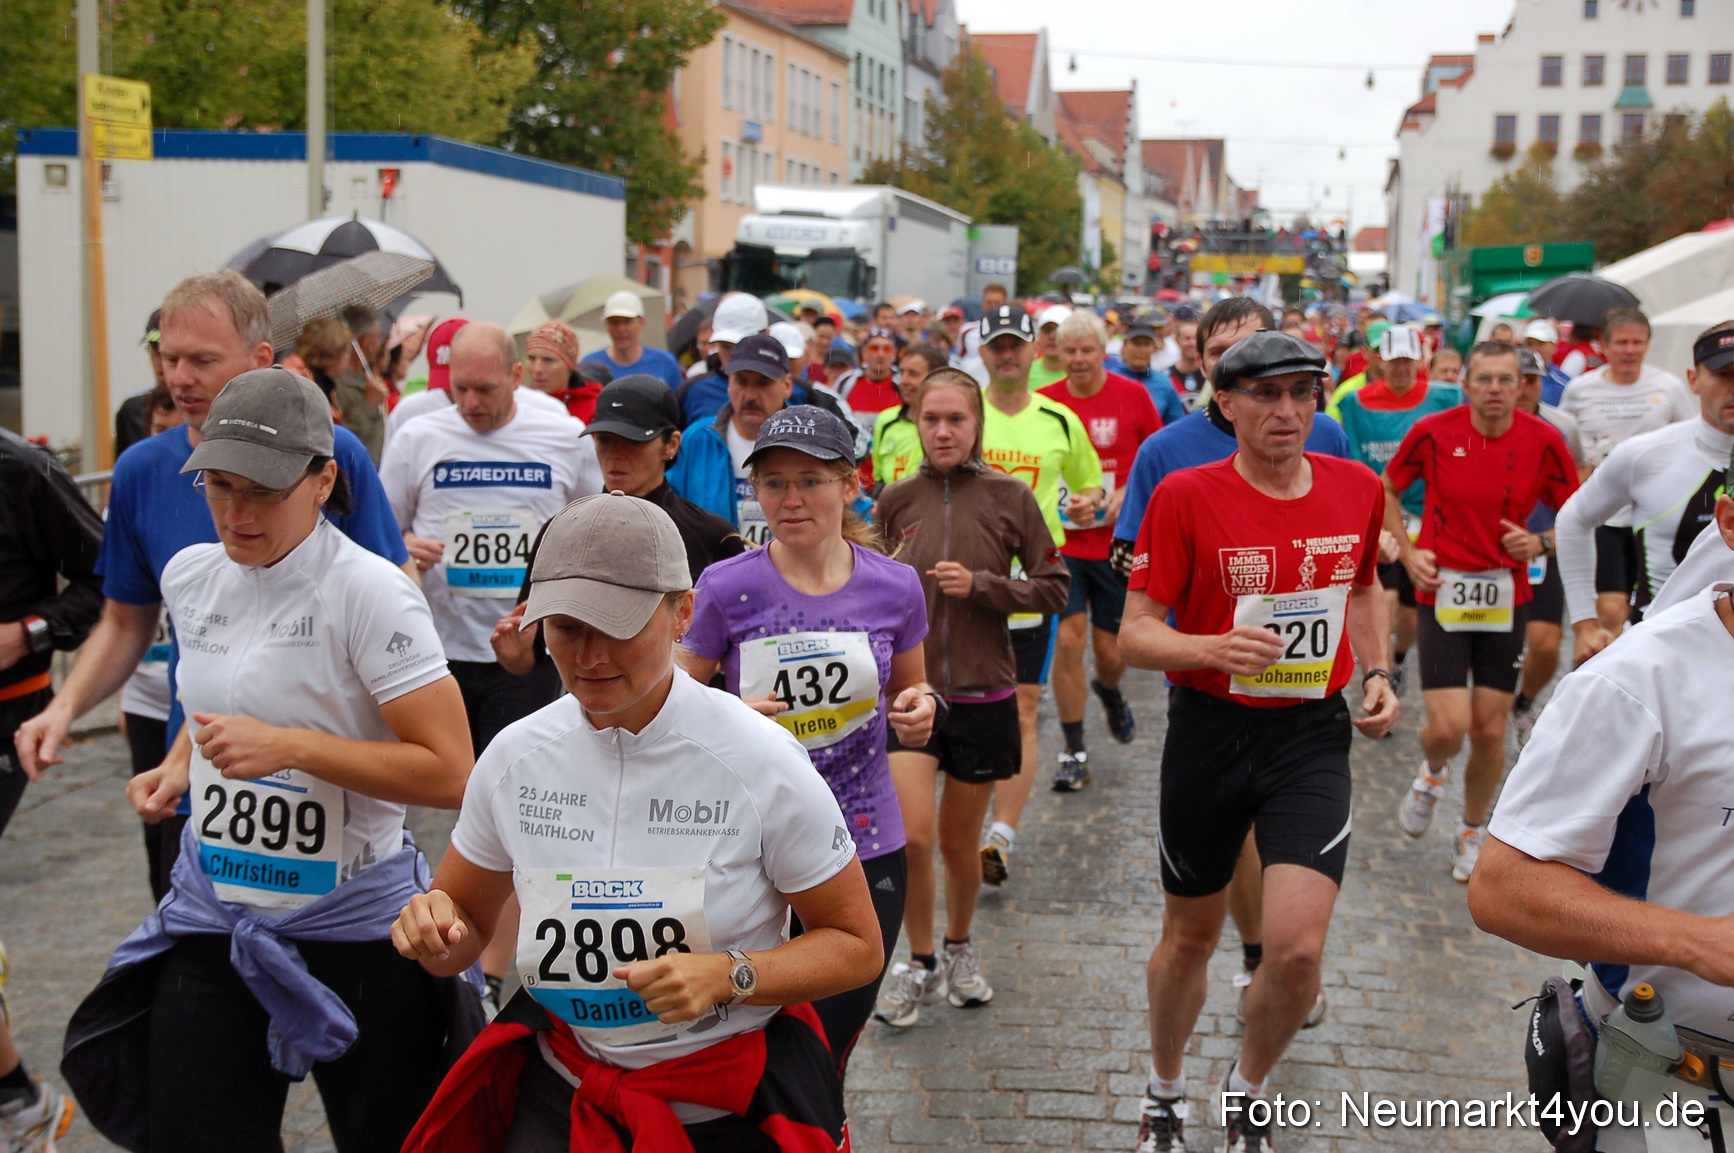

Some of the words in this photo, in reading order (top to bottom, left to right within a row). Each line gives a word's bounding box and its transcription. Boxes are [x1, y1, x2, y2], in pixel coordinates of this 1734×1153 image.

[450, 468, 546, 483] STAEDTLER
[454, 533, 531, 565] 2684
[1292, 539, 1306, 549] 11.
[1306, 534, 1361, 547] NEUMARKTER
[1305, 544, 1353, 556] STADTLAUF
[1229, 555, 1268, 566] IMMER
[1227, 565, 1271, 575] WIEDER
[469, 572, 515, 586] Markus
[1231, 574, 1268, 587] NEU
[1231, 587, 1267, 596] MARKT
[1453, 582, 1498, 606] 340
[1273, 597, 1319, 612] BOCK
[778, 639, 830, 656] BOCK
[1255, 669, 1328, 684] Johannes
[769, 661, 851, 711] 432
[794, 717, 838, 736] Irene
[519, 785, 537, 801] 25
[541, 790, 587, 807] JAHRE
[201, 784, 326, 855] 2899
[518, 803, 562, 822] CELLER
[649, 798, 730, 824] Mobil
[519, 820, 595, 842] TRIATHLON
[647, 826, 741, 837] BETRIEBSKRANKENKASSE
[210, 853, 300, 888] Christine
[571, 880, 644, 898] BOCK
[535, 917, 692, 983] 2898
